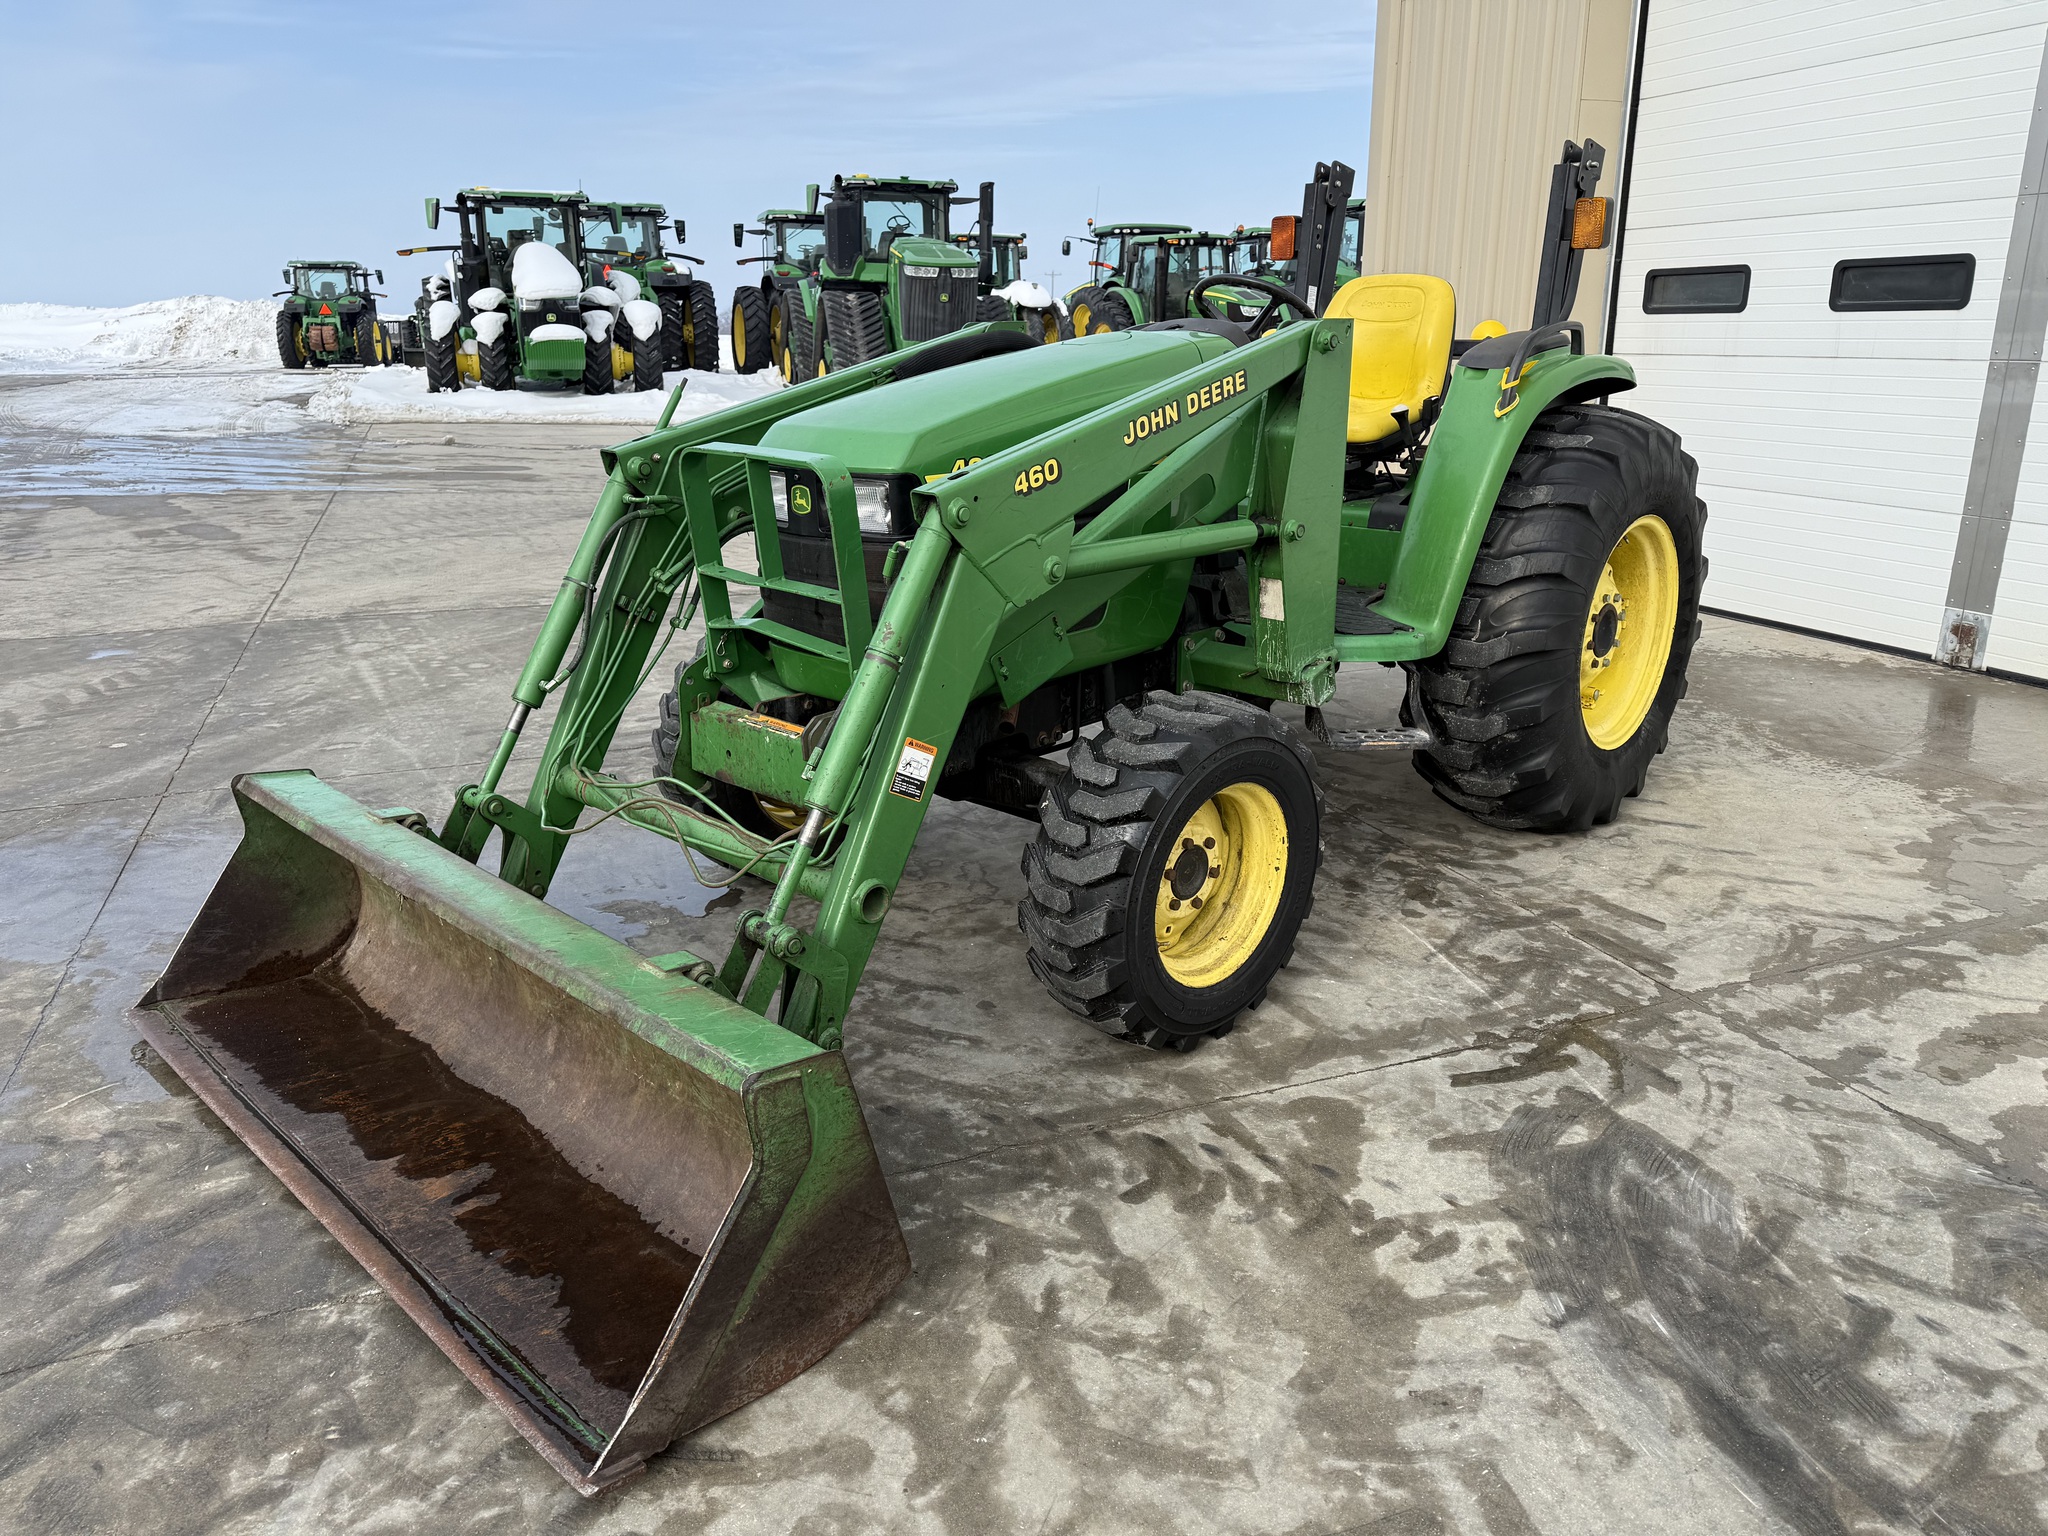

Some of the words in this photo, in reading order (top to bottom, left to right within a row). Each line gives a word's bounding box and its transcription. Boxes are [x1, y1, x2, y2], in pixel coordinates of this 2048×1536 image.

[1123, 400, 1180, 446] JOHN
[1186, 369, 1247, 416] DEERE
[1014, 458, 1061, 495] 460
[914, 742, 935, 754] WARNING
